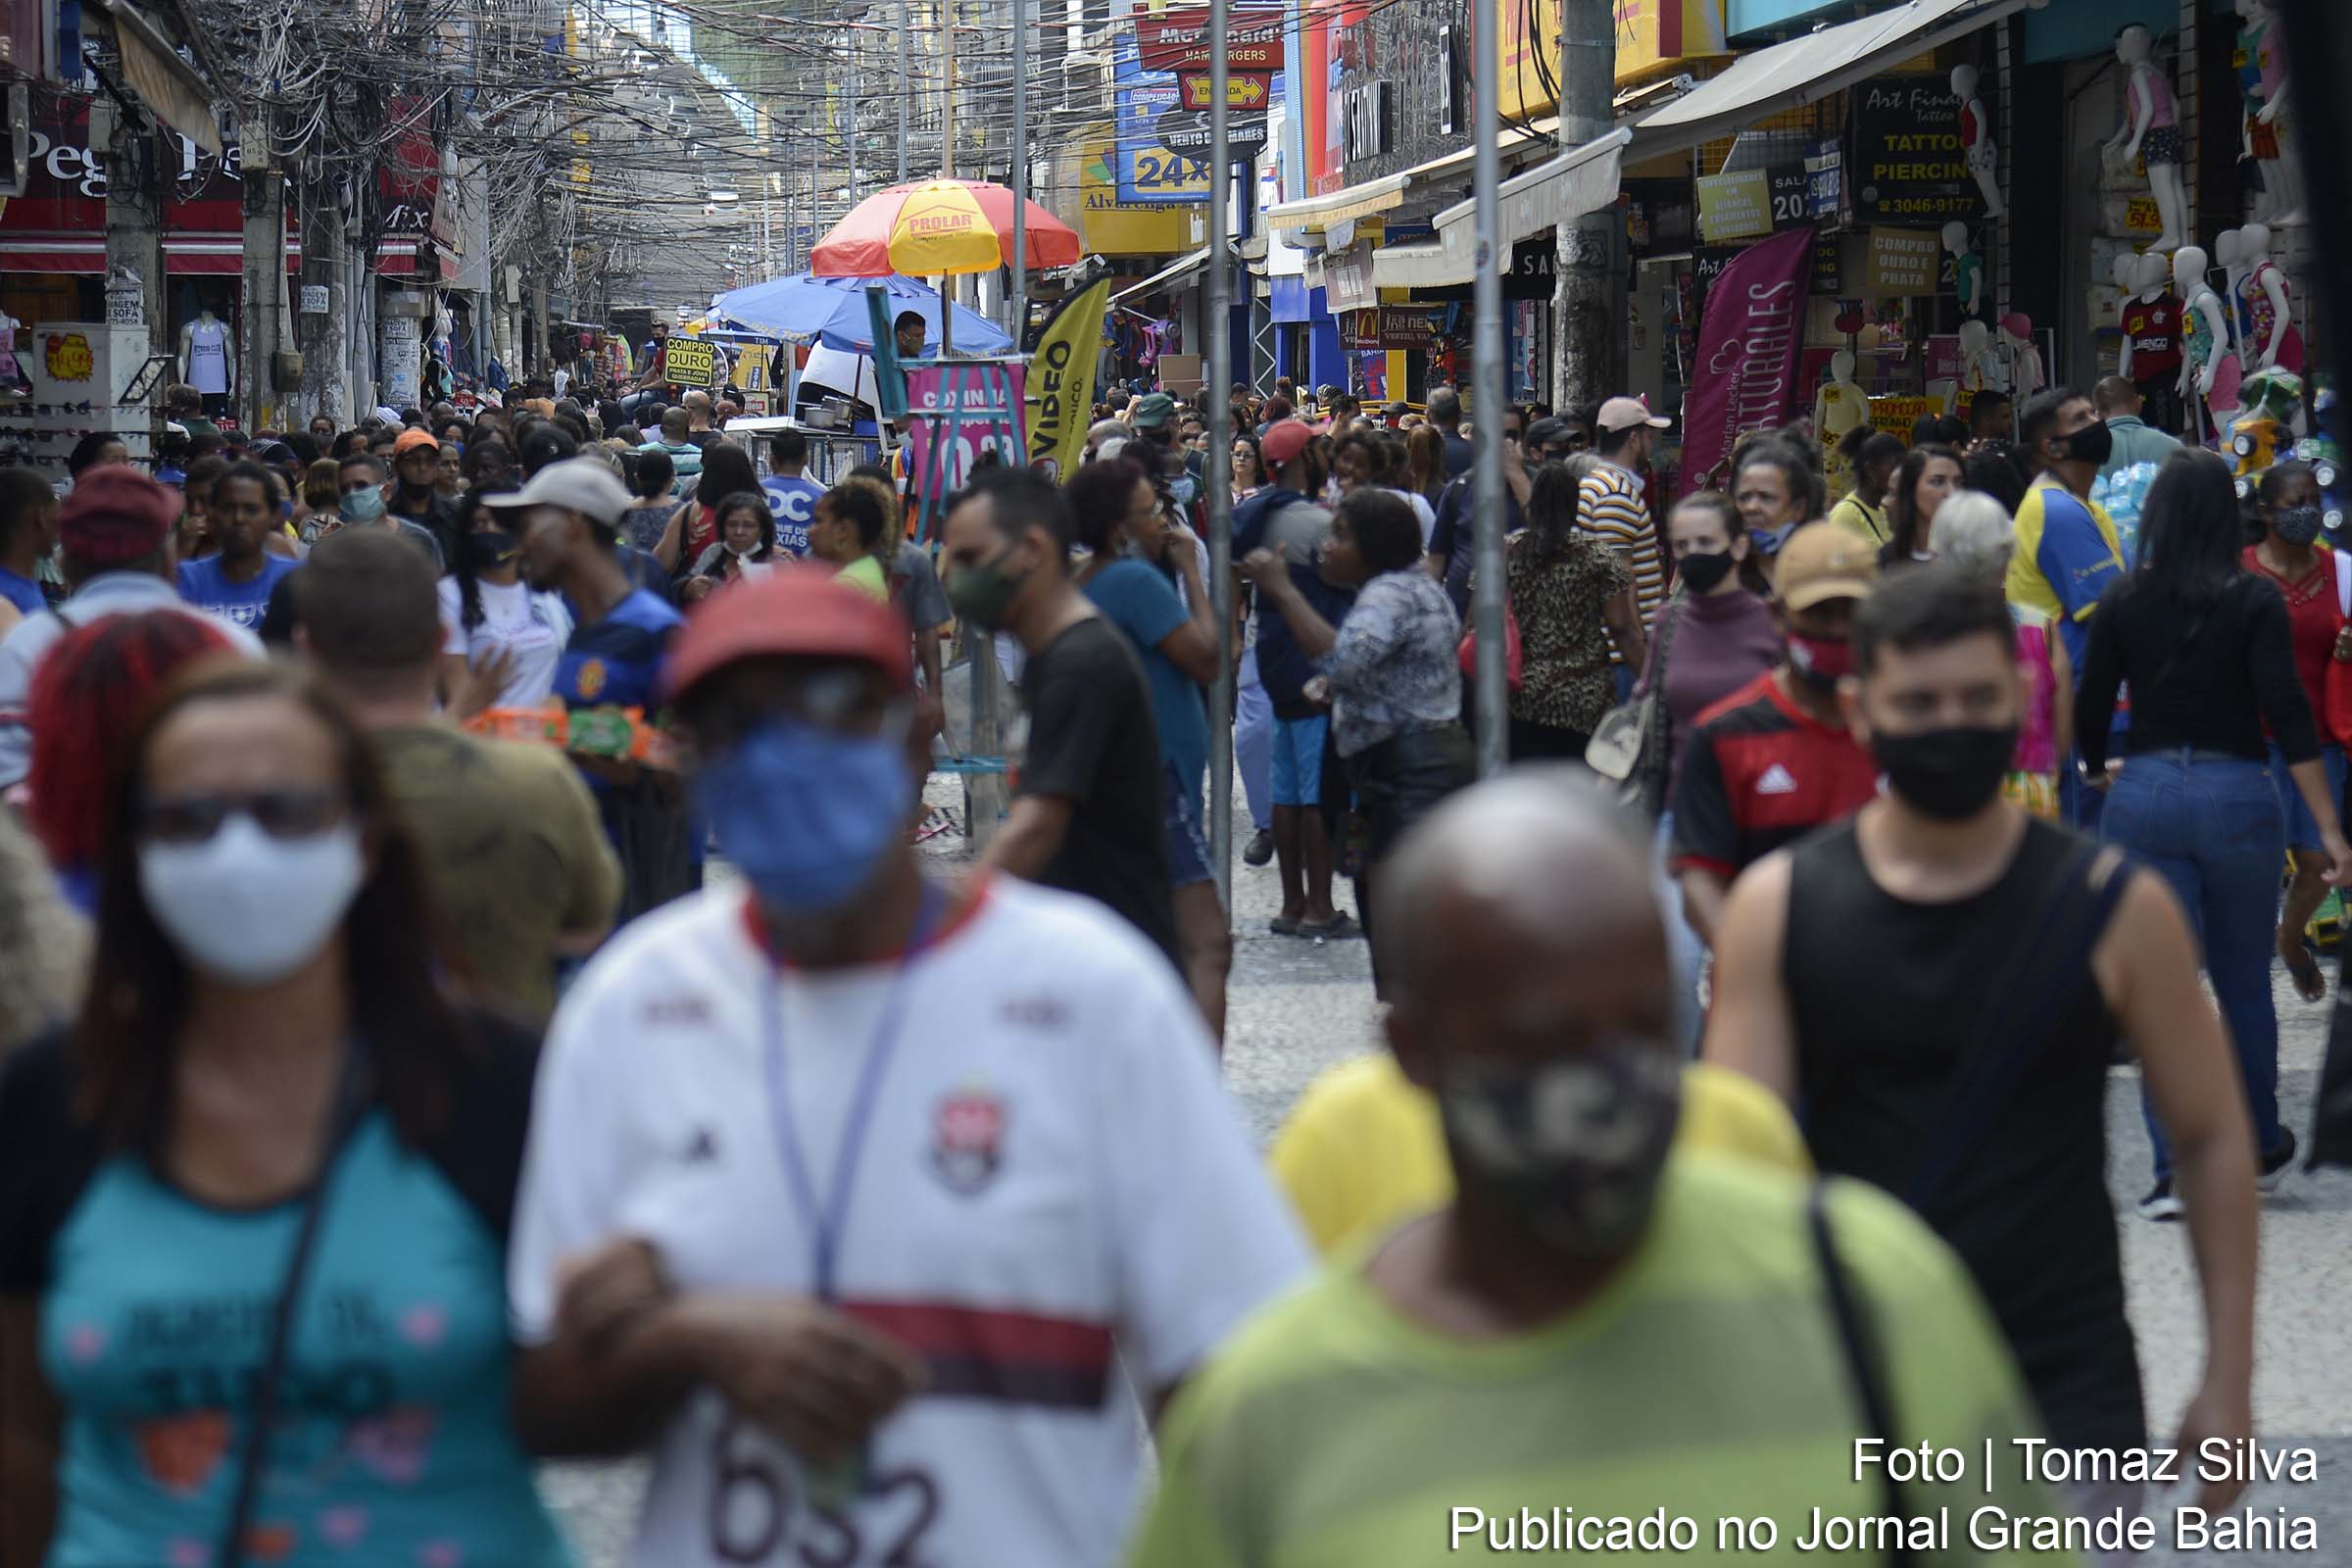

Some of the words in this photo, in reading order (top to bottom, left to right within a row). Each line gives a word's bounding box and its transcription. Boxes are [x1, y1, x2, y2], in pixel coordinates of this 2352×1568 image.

[1186, 50, 1267, 61] HAMRGERS
[1866, 87, 1903, 111] Art
[1884, 133, 1963, 152] TATTO
[1873, 162, 1969, 180] PIERCIN
[1775, 175, 1806, 188] SAL
[1774, 194, 1810, 220] 20
[909, 214, 972, 232] PROLAR
[1875, 235, 1936, 253] COMPRO
[1879, 254, 1919, 269] OURO
[1921, 257, 1930, 268] E
[1881, 271, 1927, 286] PRATA
[666, 338, 714, 354] COMPRO
[667, 352, 711, 368] OURO
[1032, 340, 1071, 458] VIDEO
